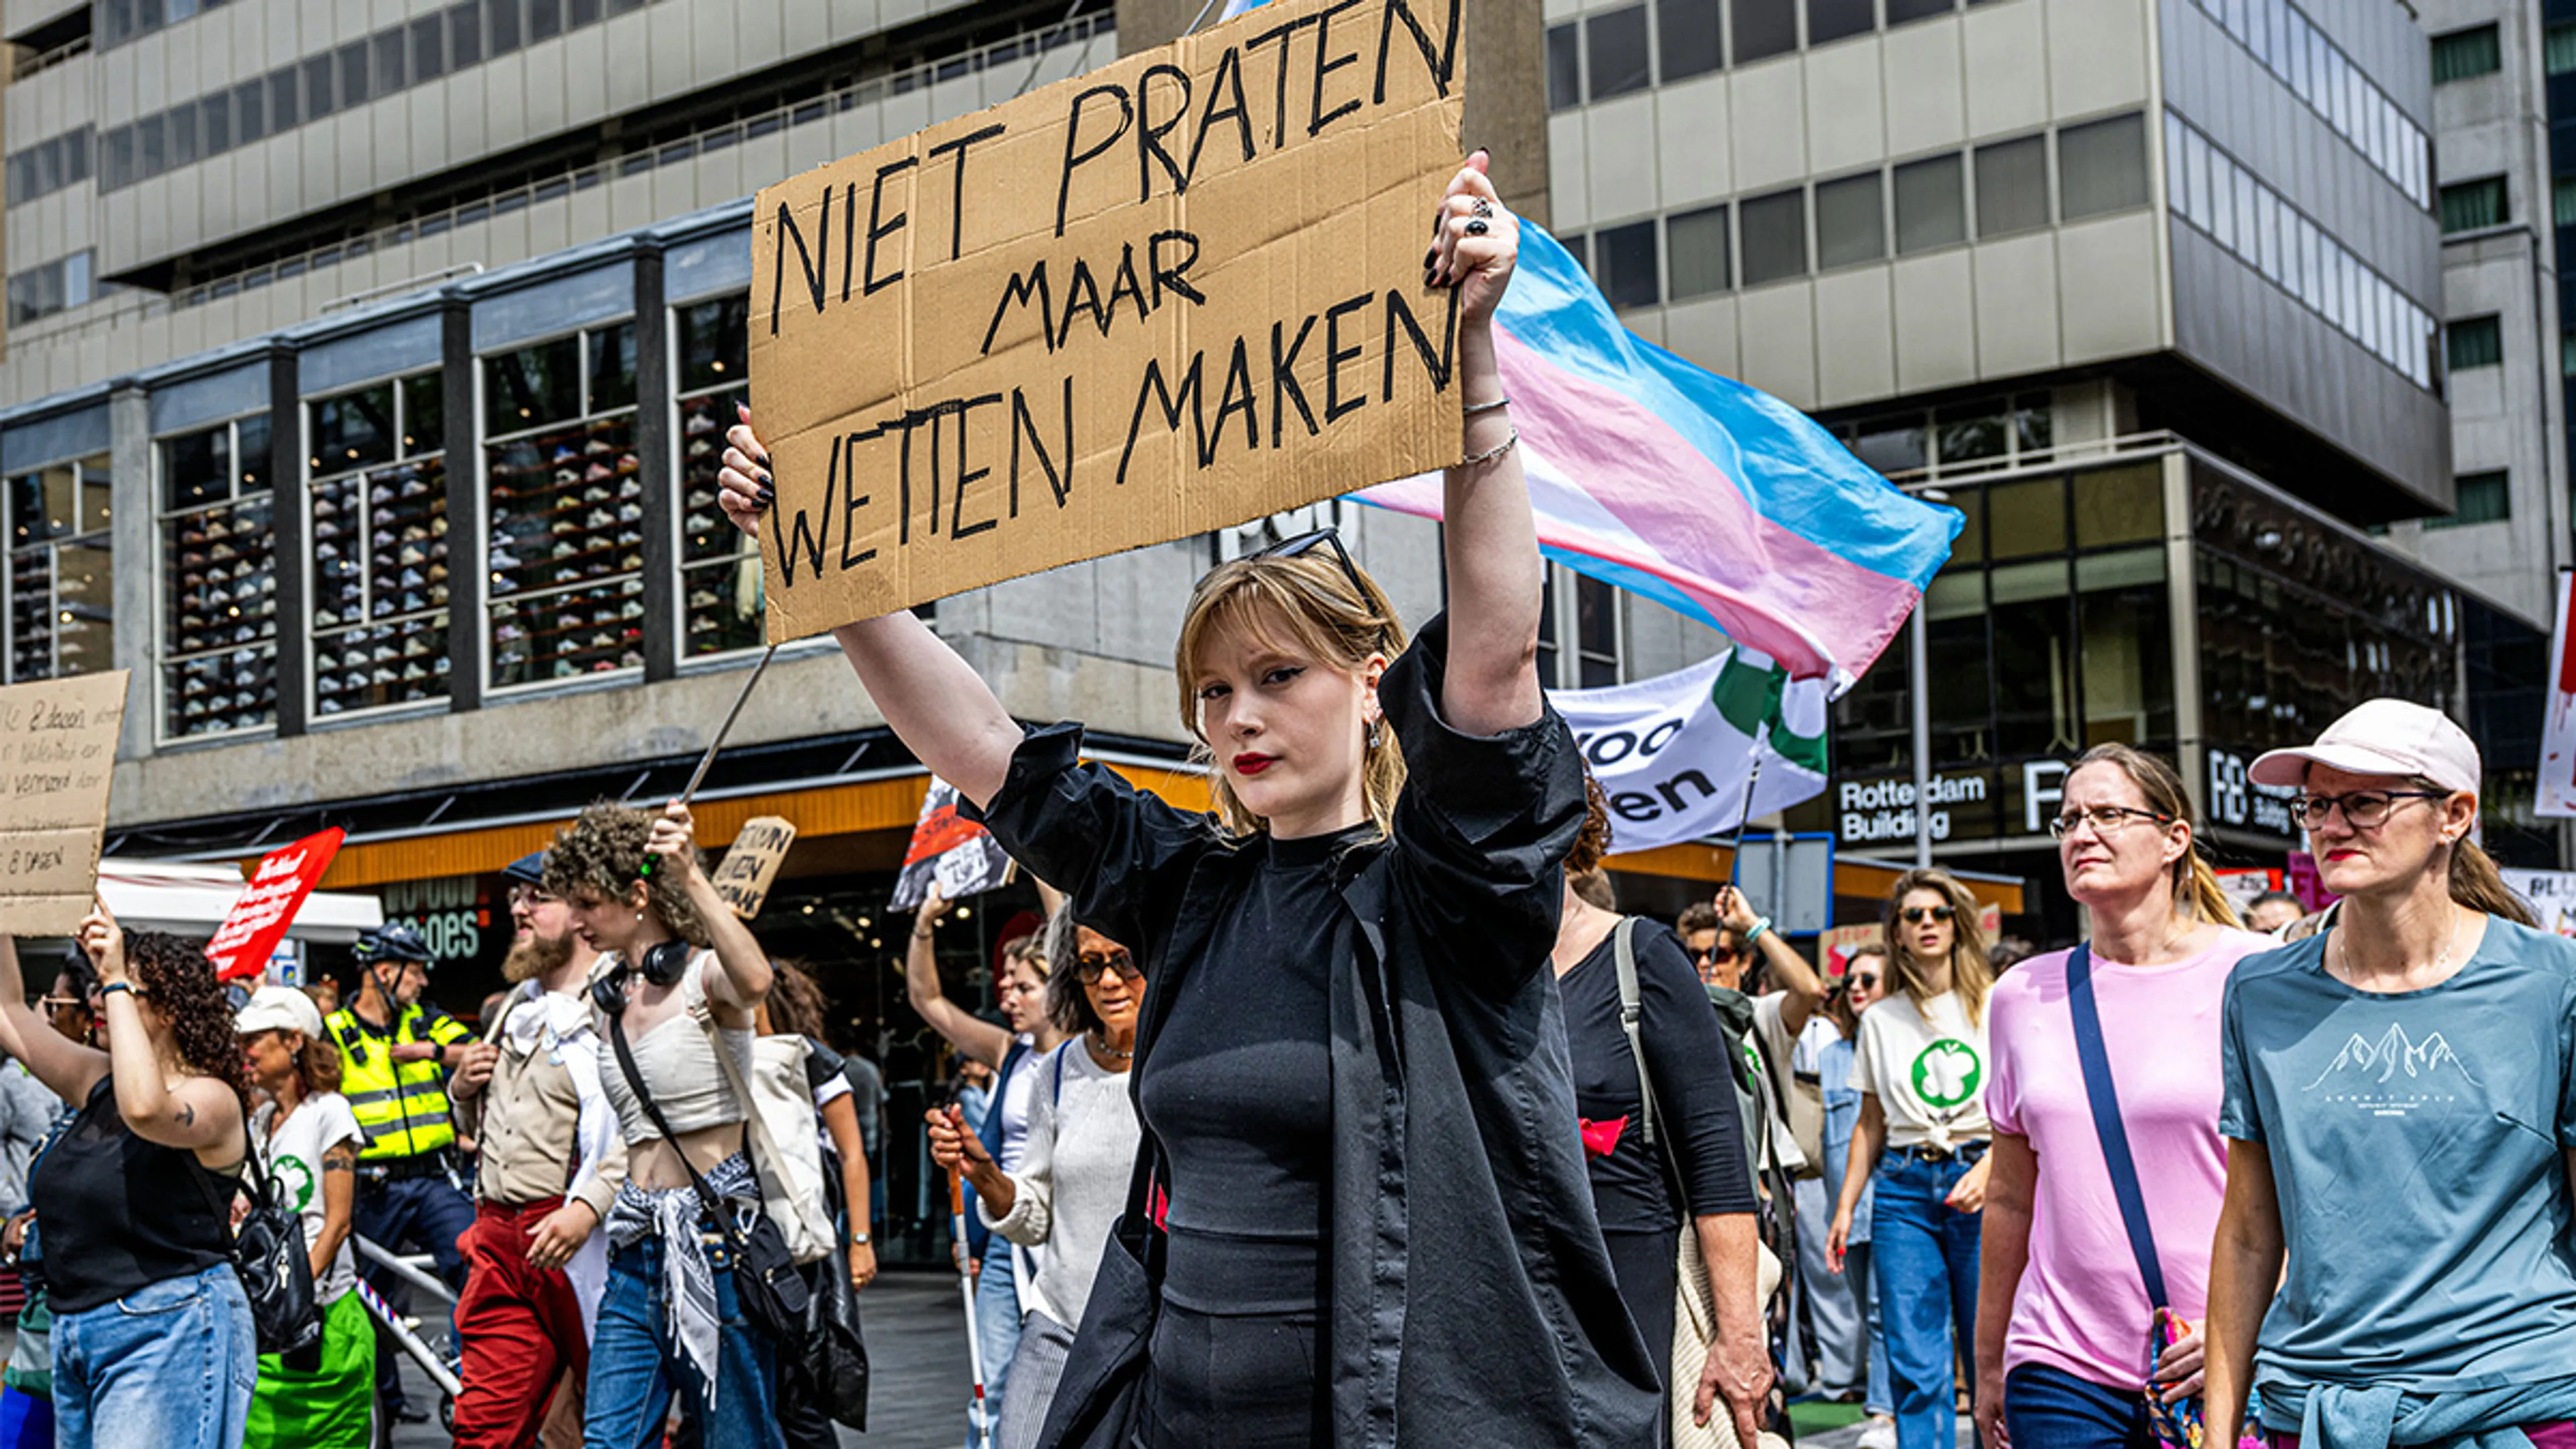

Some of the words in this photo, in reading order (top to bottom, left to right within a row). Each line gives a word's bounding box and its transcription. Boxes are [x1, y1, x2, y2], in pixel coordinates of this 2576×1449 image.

[771, 123, 1006, 339] NIET
[1055, 0, 1460, 238] PRATEN
[980, 230, 1205, 355] MAAR
[769, 374, 1073, 588] WETTEN
[1116, 283, 1461, 484] MAKEN
[1840, 773, 1986, 810] Rottedam
[1842, 809, 1949, 842] Buildig
